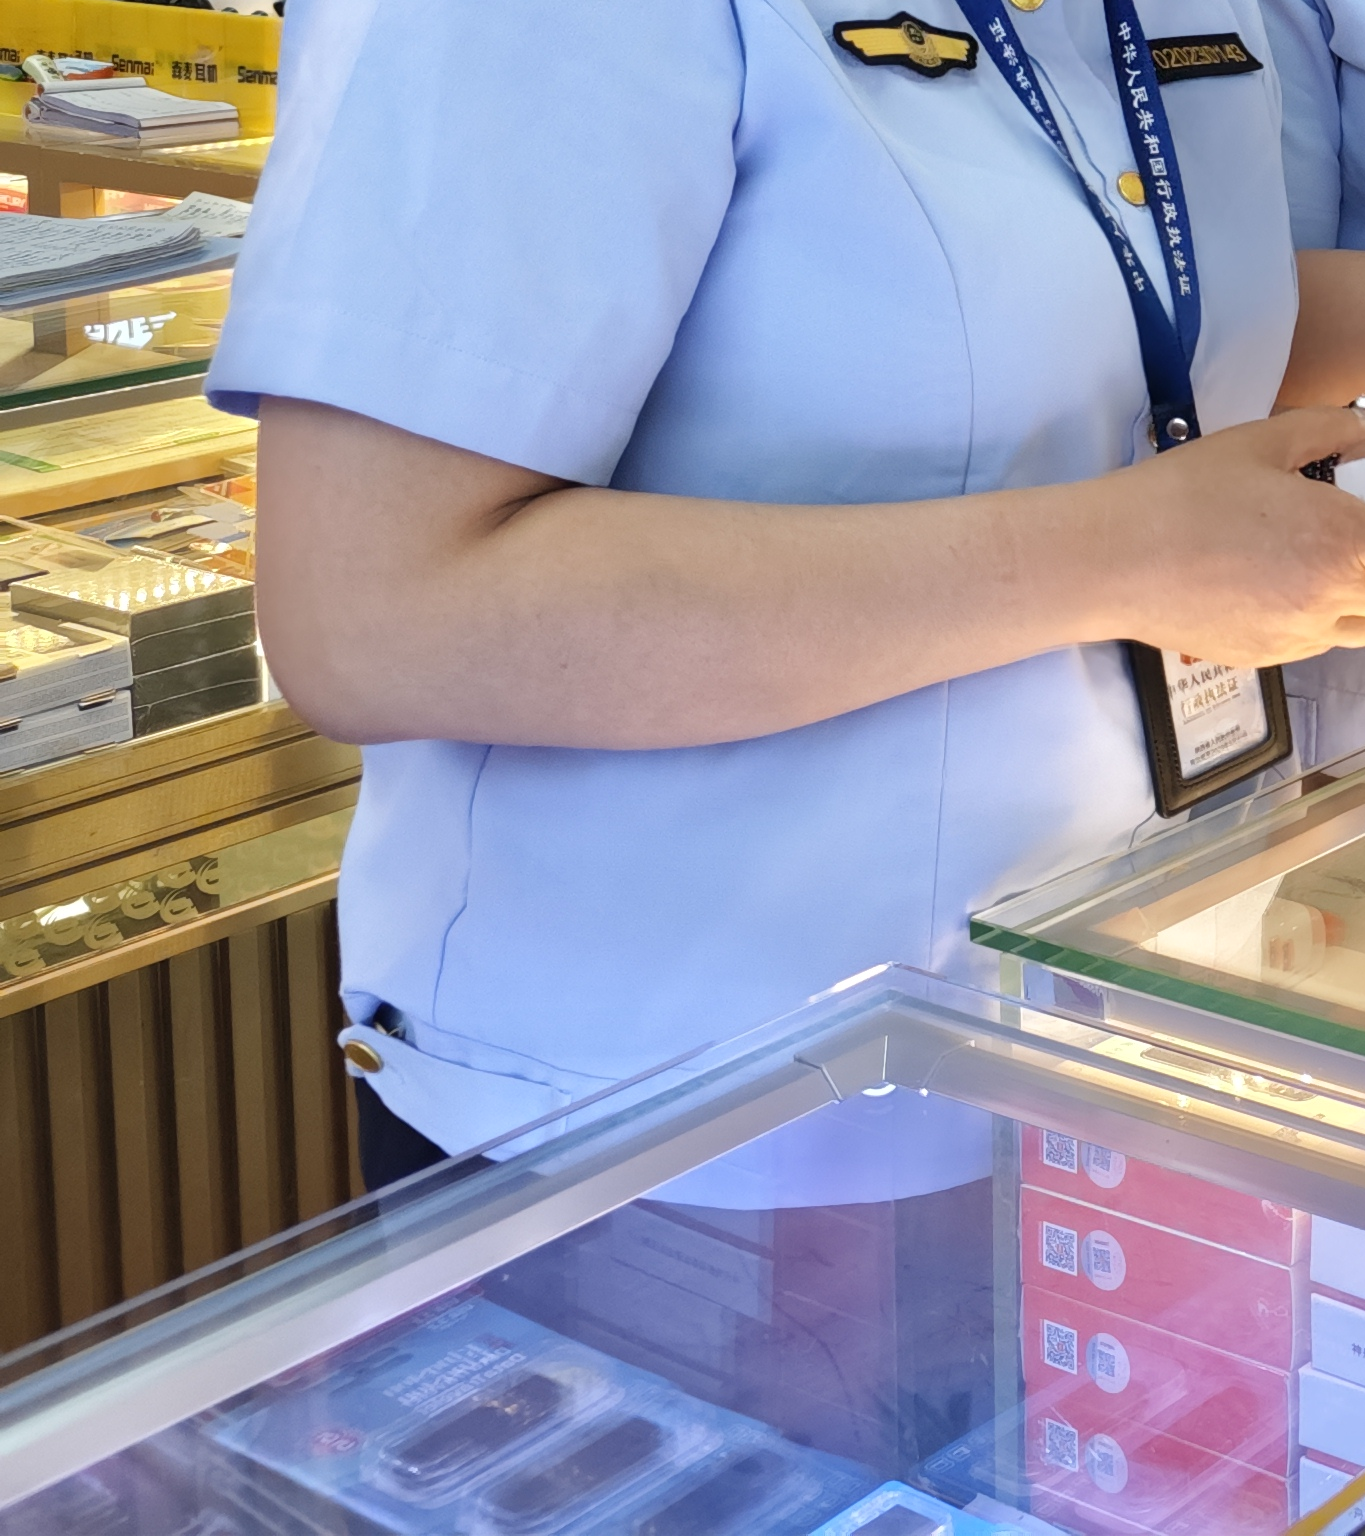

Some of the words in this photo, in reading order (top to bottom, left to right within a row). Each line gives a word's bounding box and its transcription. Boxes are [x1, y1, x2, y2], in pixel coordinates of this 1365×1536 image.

[1118, 20, 1192, 298] 中华人民共和国行政执法证
